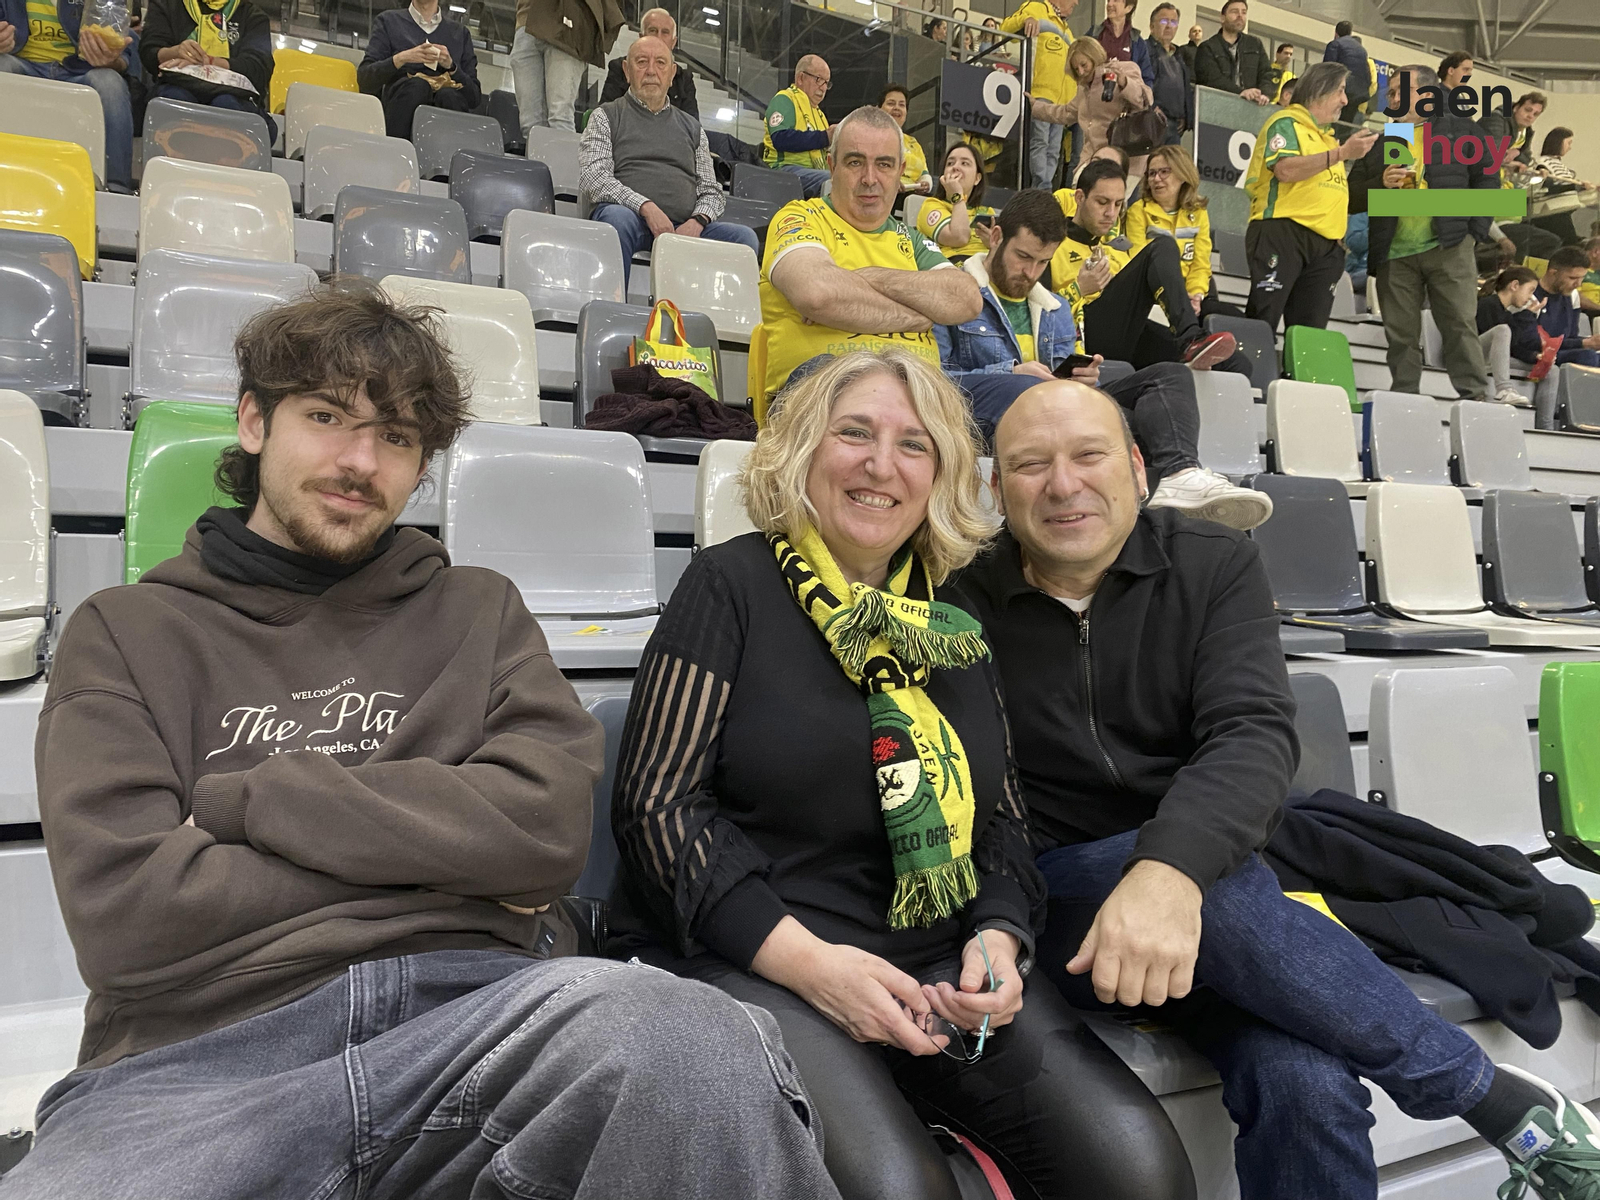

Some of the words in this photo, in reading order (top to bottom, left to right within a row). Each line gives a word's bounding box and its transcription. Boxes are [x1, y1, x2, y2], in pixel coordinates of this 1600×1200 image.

[982, 70, 1021, 138] 9
[1228, 130, 1257, 189] 9
[291, 684, 341, 702] WELCOME
[341, 676, 356, 687] TO
[204, 704, 303, 760] The
[306, 691, 407, 739] Pla
